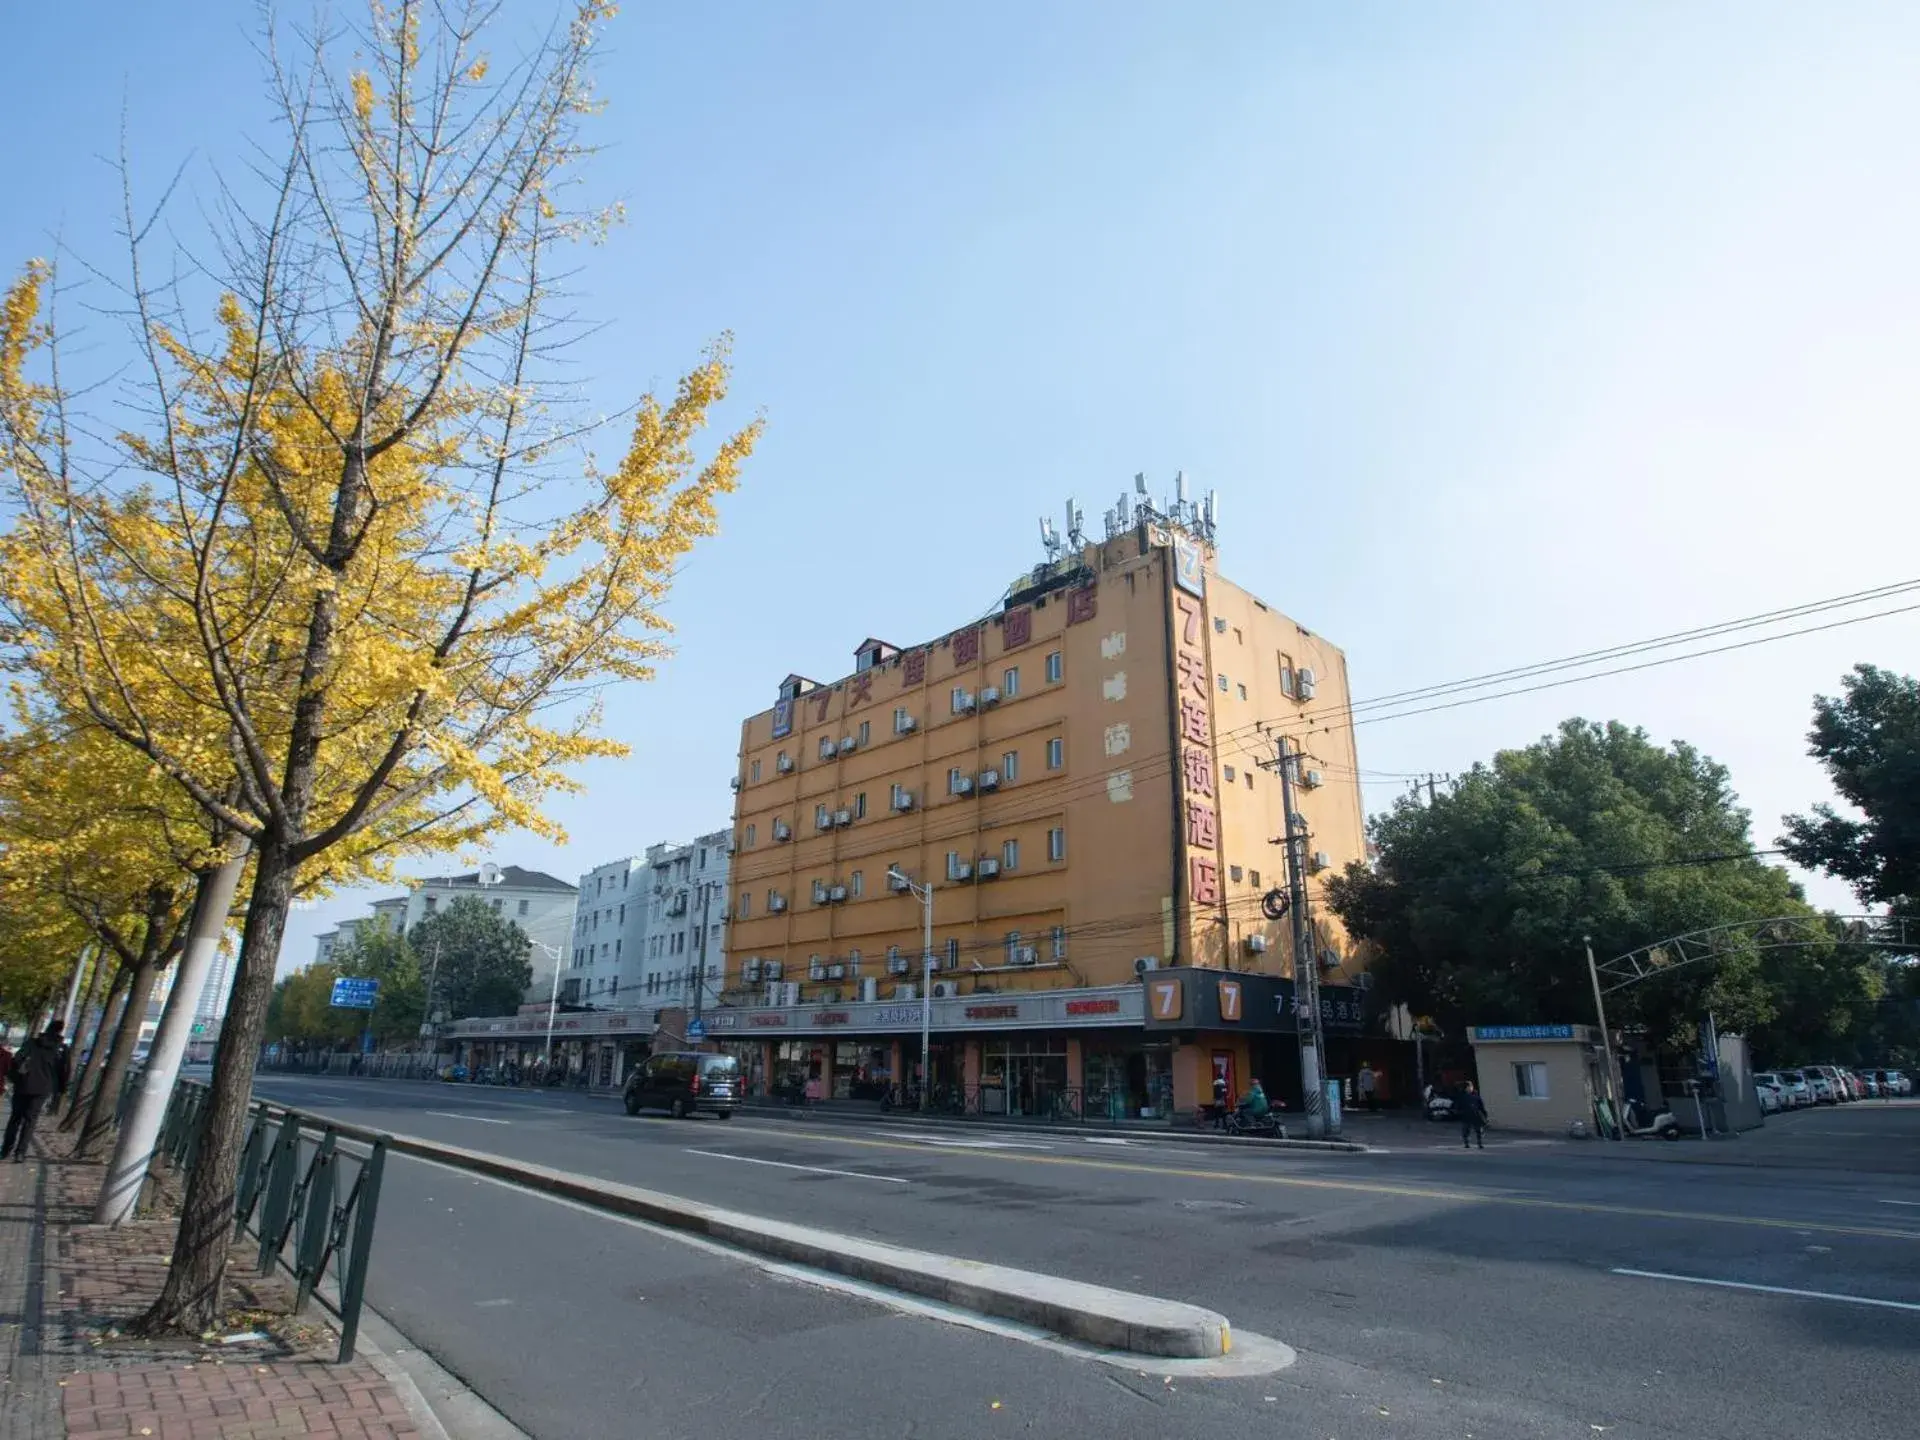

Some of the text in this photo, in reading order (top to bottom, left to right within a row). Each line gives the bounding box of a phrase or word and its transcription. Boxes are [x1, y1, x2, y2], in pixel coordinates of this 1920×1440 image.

[808, 584, 1097, 722] 7天连锁酒店
[1177, 596, 1219, 906] 7天连锁酒店
[1156, 986, 1175, 1015] 7
[1222, 987, 1237, 1016] 7
